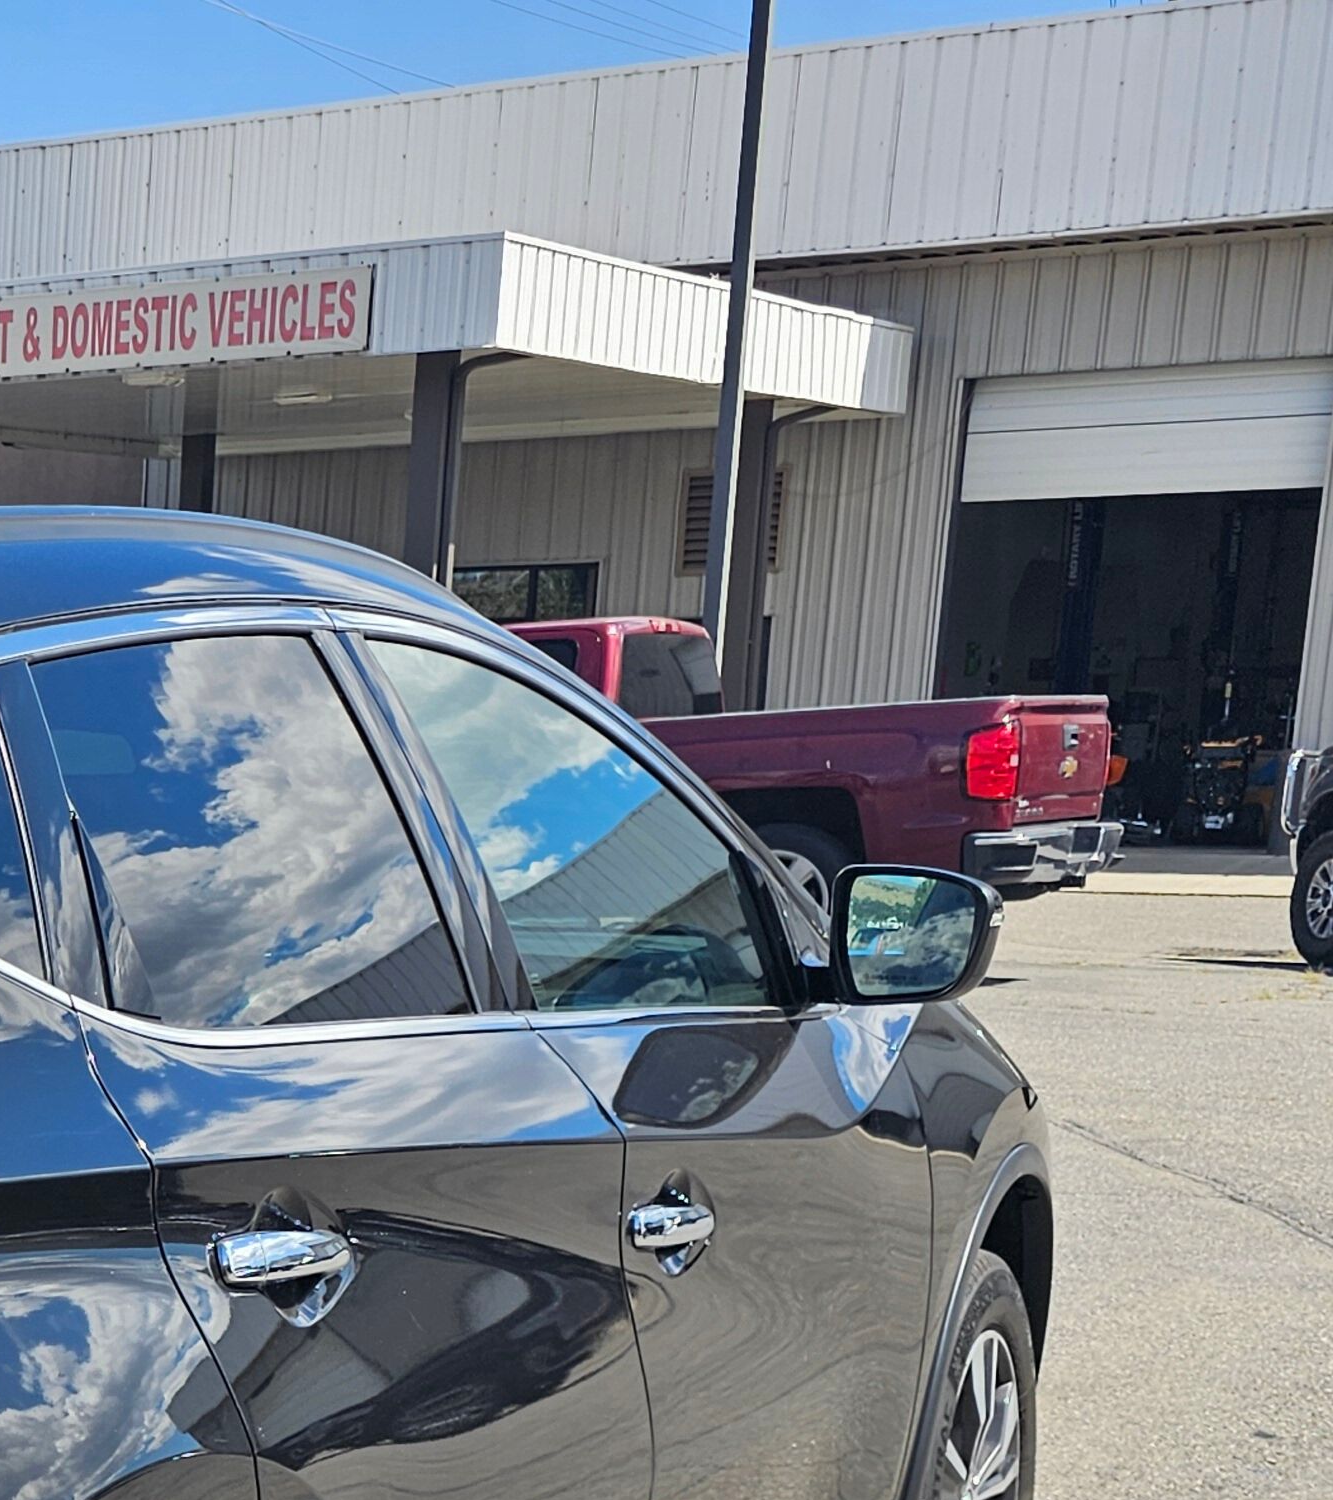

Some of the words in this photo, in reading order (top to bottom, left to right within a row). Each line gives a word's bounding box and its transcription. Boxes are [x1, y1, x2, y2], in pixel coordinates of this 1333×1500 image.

[22, 306, 41, 363] &
[51, 292, 197, 360] DOMESTIC
[208, 279, 357, 348] VEHICLES
